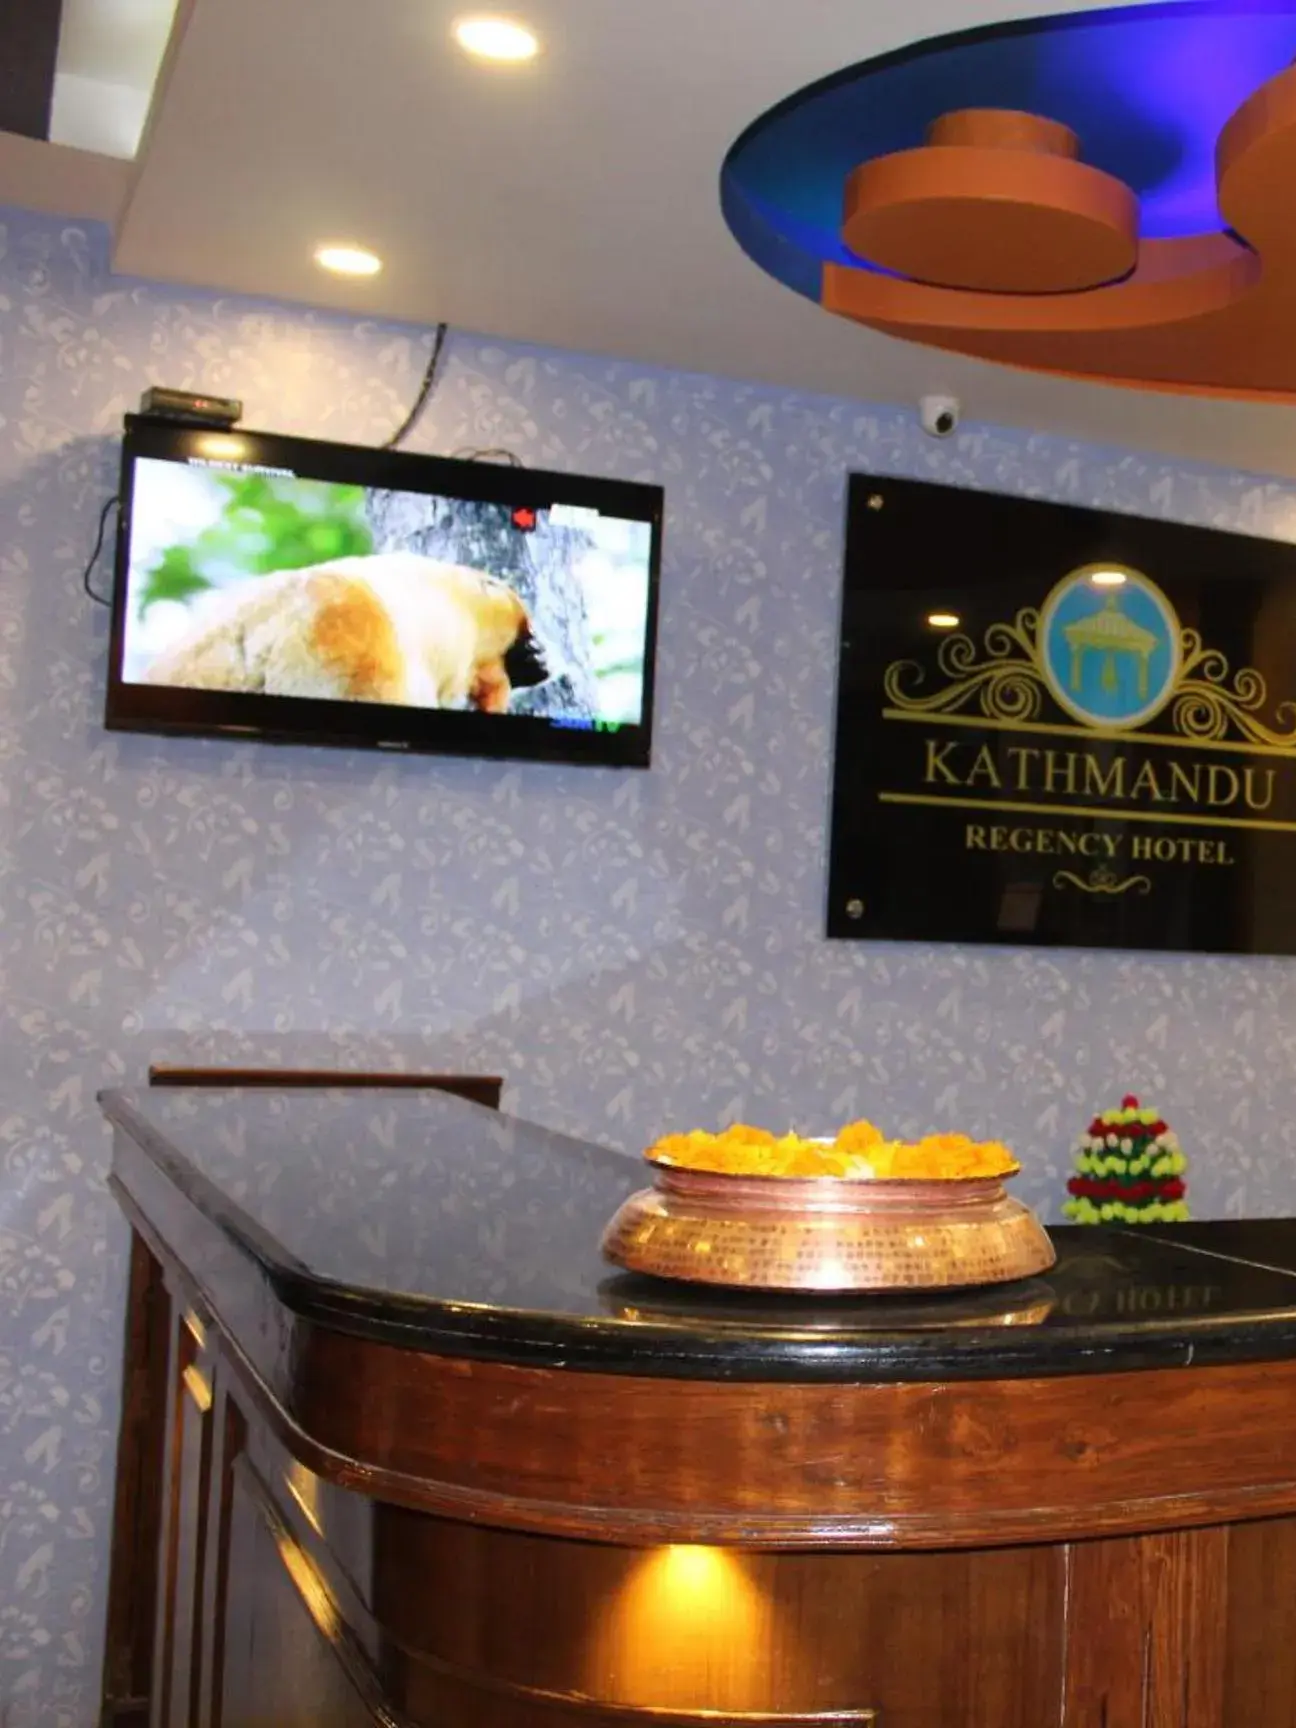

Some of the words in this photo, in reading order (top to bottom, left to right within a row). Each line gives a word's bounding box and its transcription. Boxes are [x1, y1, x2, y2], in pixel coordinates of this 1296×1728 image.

[924, 739, 1276, 811] KATHMANDU
[965, 824, 1124, 859] REGENCY
[1131, 836, 1235, 865] HOTEL
